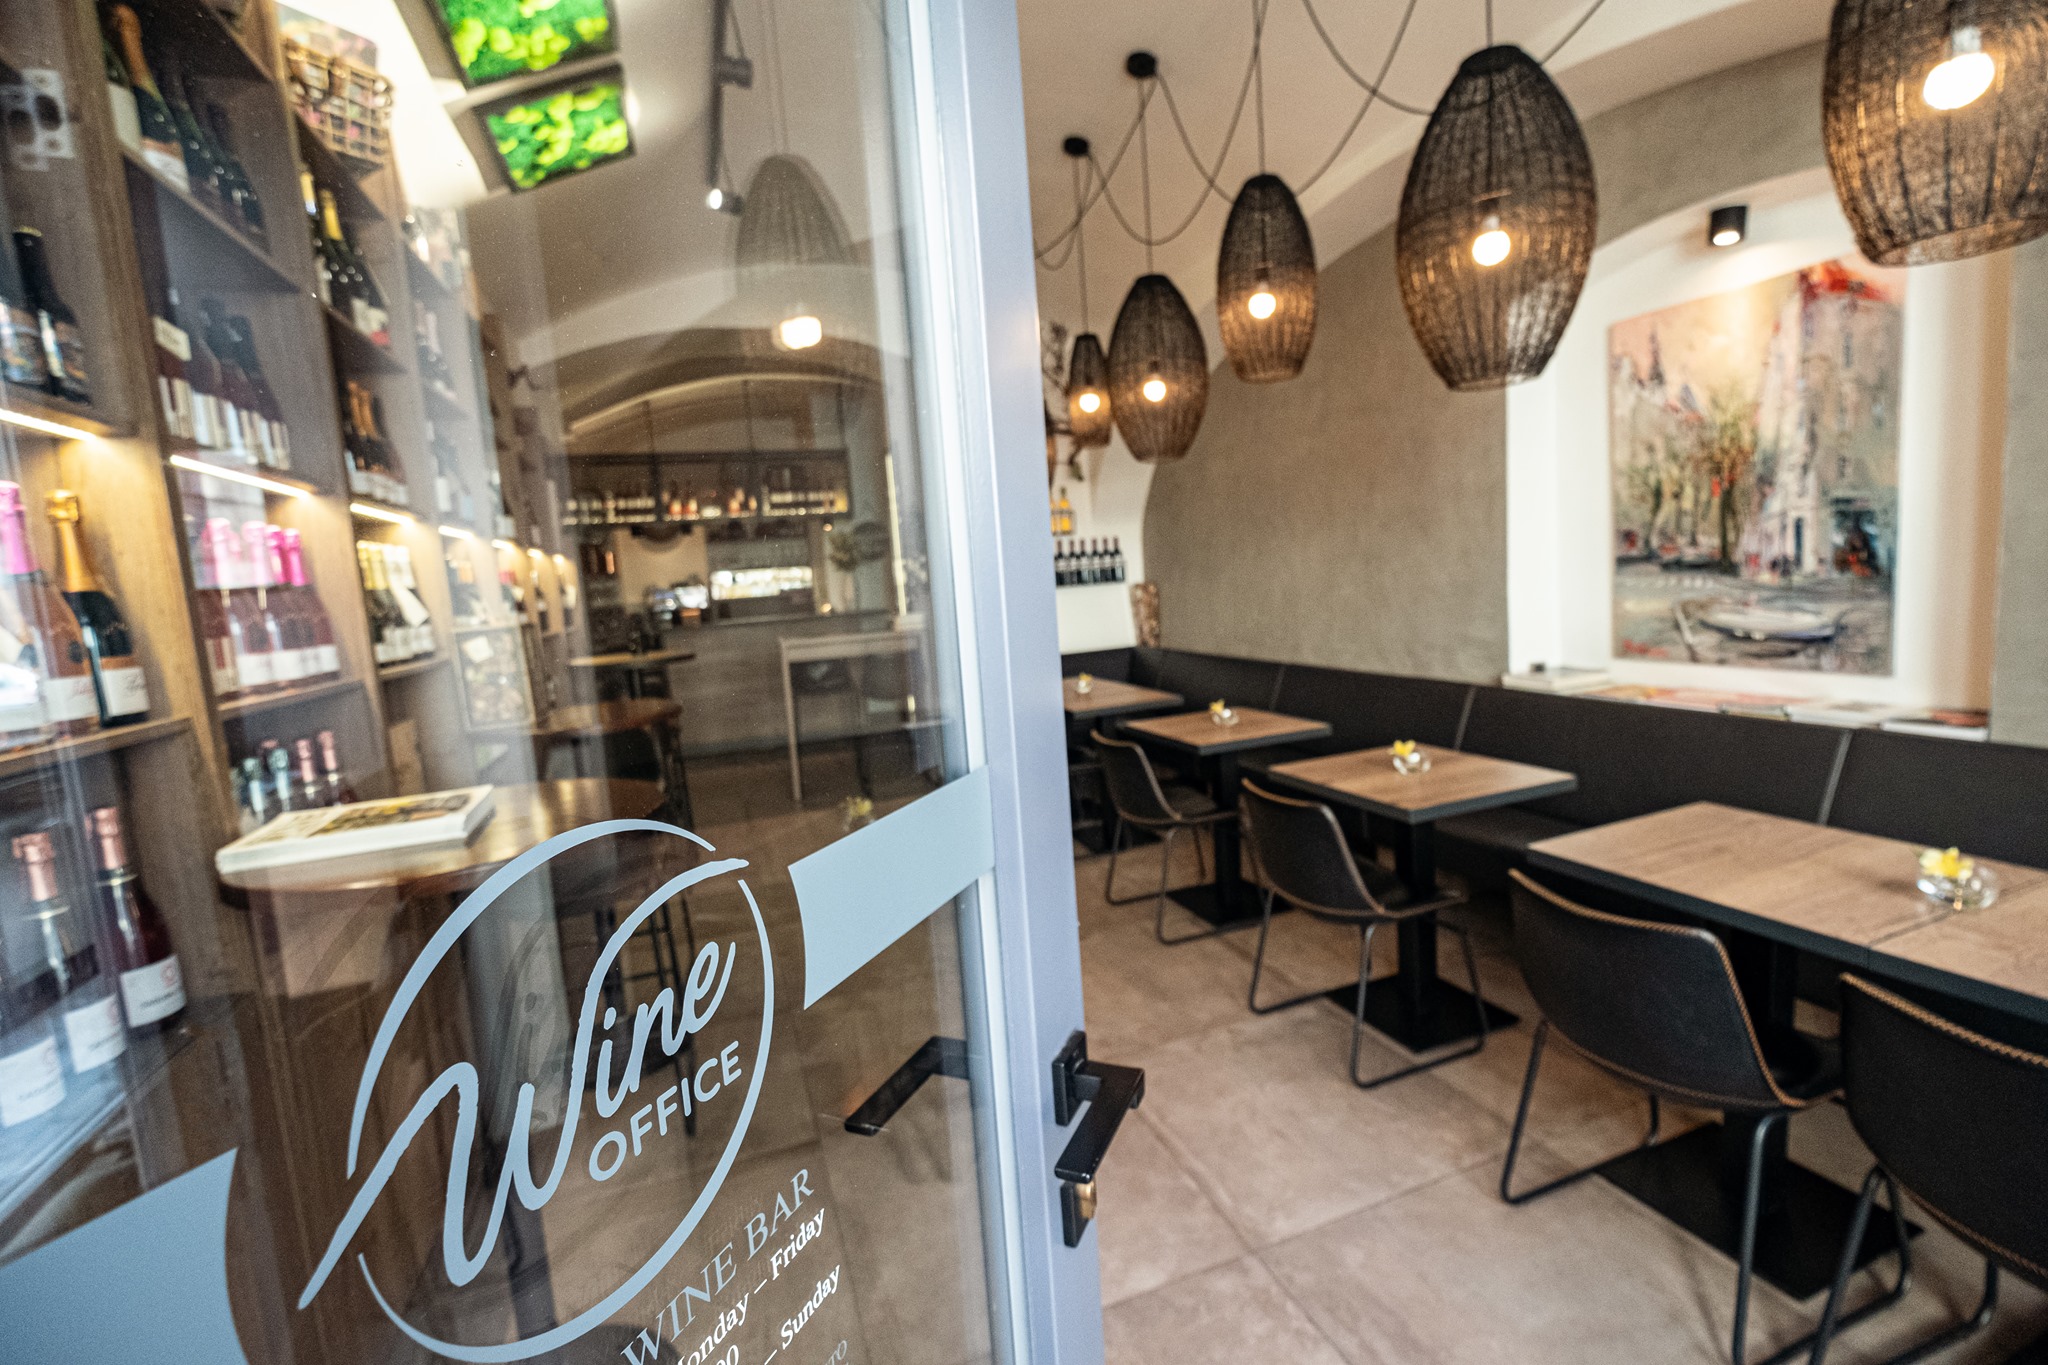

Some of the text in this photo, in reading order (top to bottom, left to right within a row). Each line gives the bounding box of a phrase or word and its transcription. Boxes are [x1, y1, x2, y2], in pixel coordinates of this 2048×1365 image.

[297, 857, 750, 1310] Wine
[588, 1040, 743, 1182] OFFICE
[619, 1168, 815, 1365] WINE BAR
[677, 1292, 749, 1365] onday
[769, 1207, 826, 1281] Friday
[780, 1264, 841, 1351] Sunday
